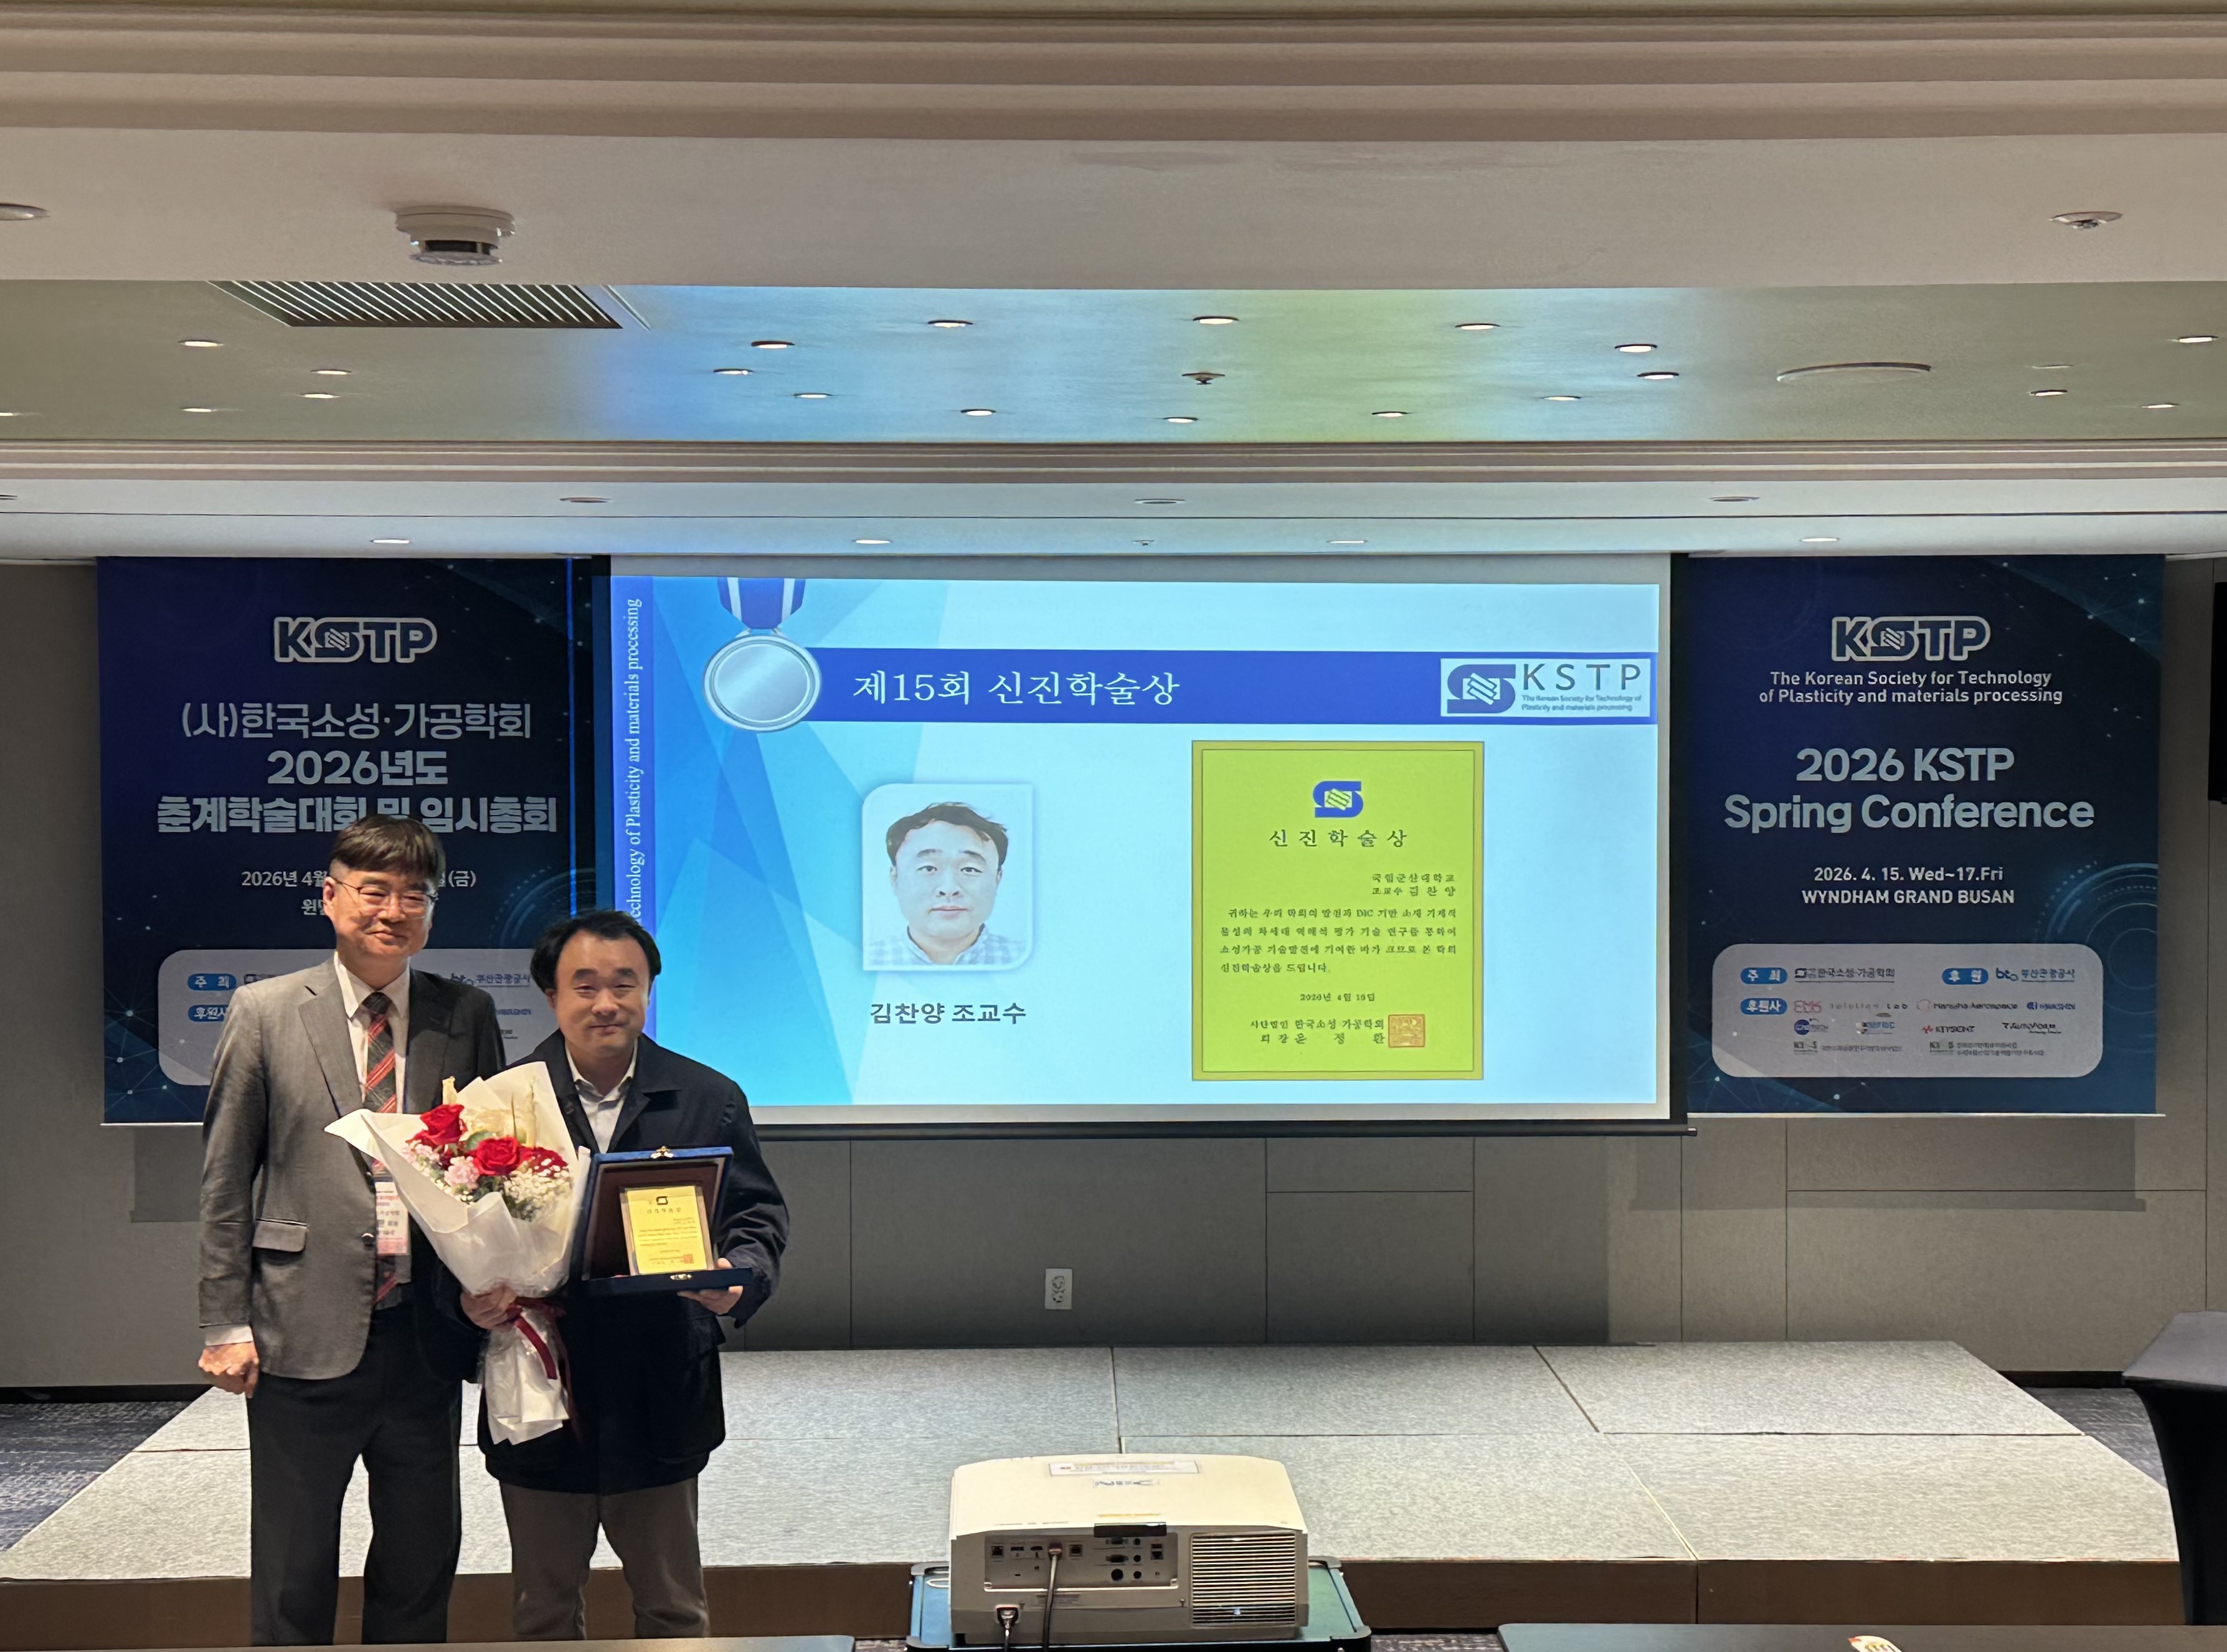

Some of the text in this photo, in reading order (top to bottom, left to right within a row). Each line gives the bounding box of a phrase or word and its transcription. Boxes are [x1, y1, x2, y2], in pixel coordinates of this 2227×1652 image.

[274, 617, 437, 663] KSTP
[1831, 615, 1991, 662] KSTP
[853, 671, 1180, 706] 제15회 신진학술상
[1523, 664, 1641, 691] KSTP
[1771, 671, 2051, 688] The Korean Society for Technology
[1759, 687, 2063, 706] of Plasticity and materials processing
[268, 750, 448, 786] 2026년도
[623, 598, 644, 924] echnology of Plasticity and materials processing
[1796, 747, 2015, 782] 2026 KSTP
[420, 795, 556, 833] 임시총회
[1724, 793, 2095, 834] Spring Conference
[242, 871, 297, 887] 2026년
[1814, 867, 1857, 881] 2026.
[1861, 867, 1875, 881] 4.
[1882, 867, 1904, 881] 15.
[1802, 889, 2015, 904] WYNDHAM GRAND BUSAN
[1356, 909, 1374, 917] DIC
[871, 1003, 1026, 1024] 김찬양 조교수
